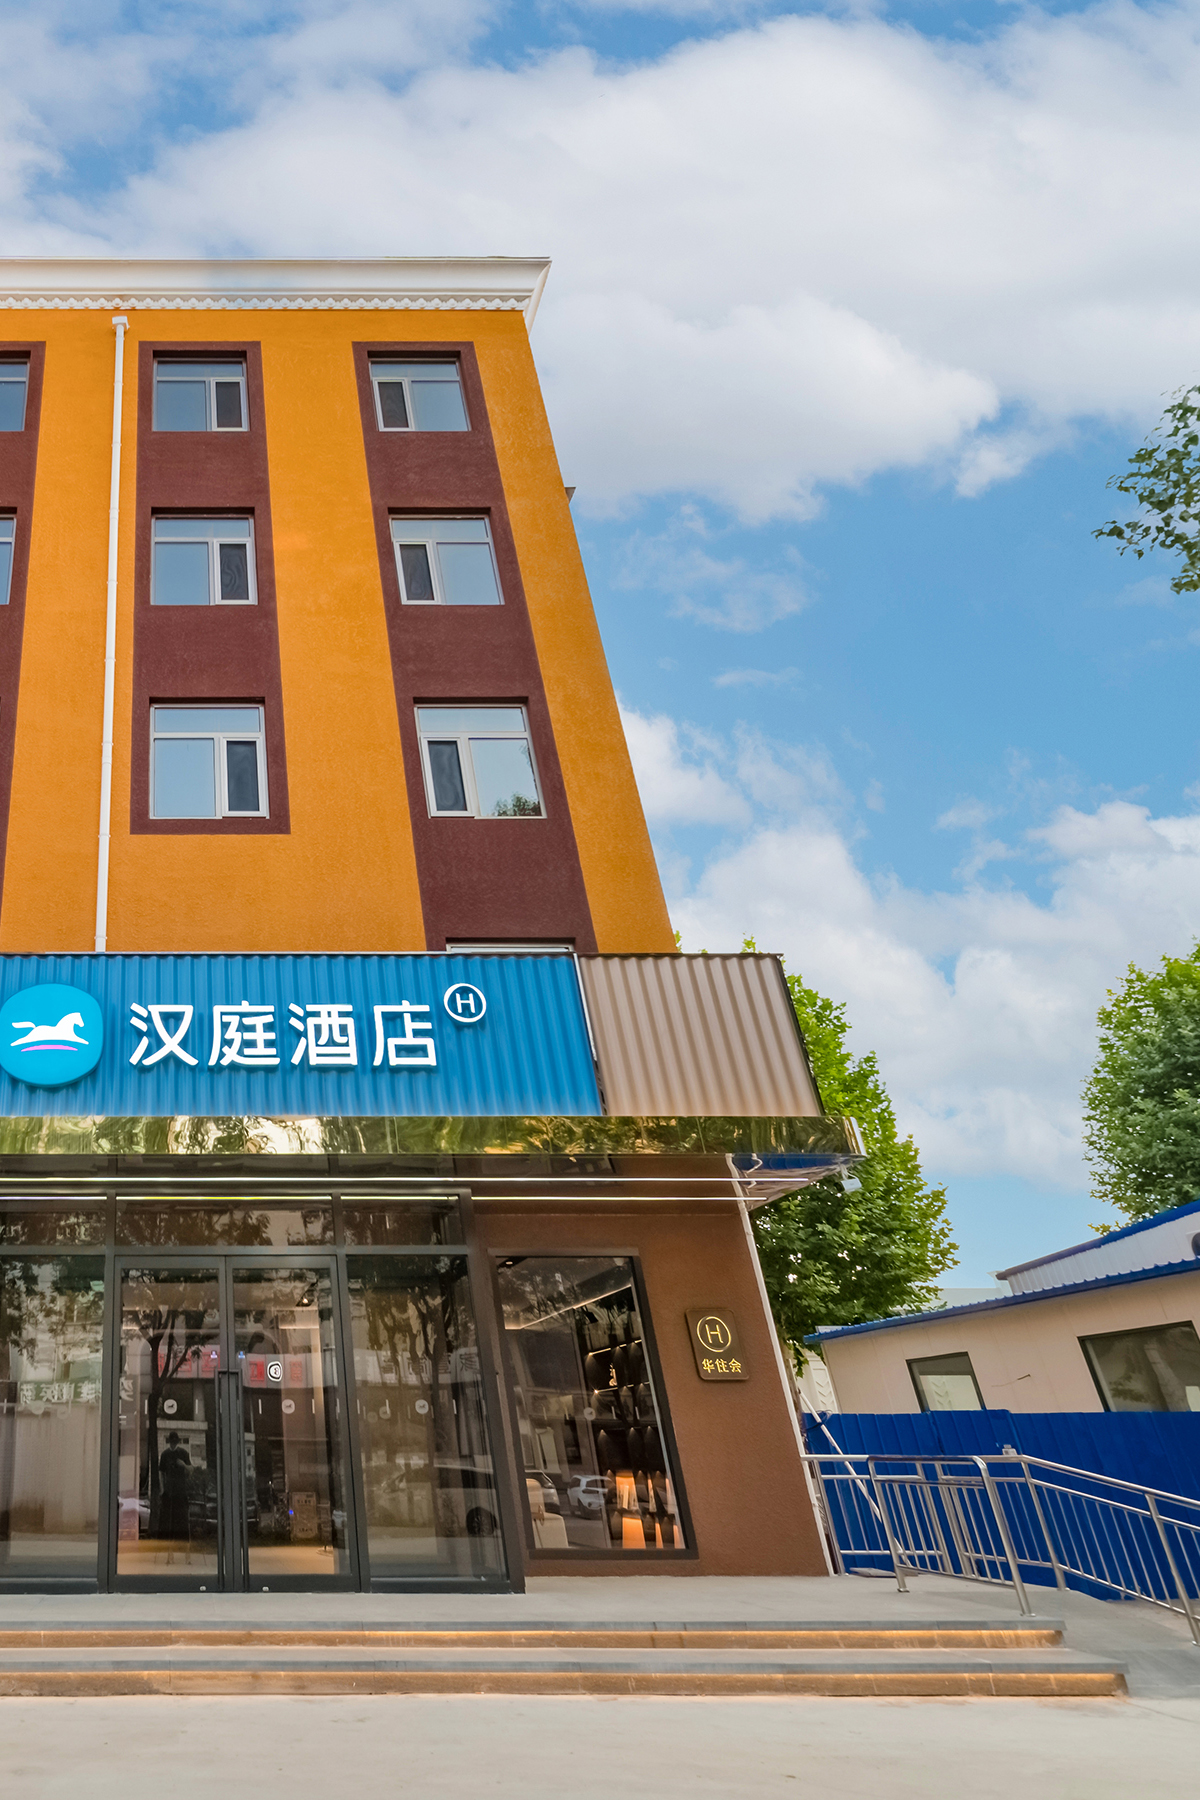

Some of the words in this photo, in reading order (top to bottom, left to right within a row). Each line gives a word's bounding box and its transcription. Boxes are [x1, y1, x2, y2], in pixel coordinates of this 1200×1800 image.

[129, 1000, 438, 1067] 汉庭酒店
[702, 1358, 741, 1373] 华住会
